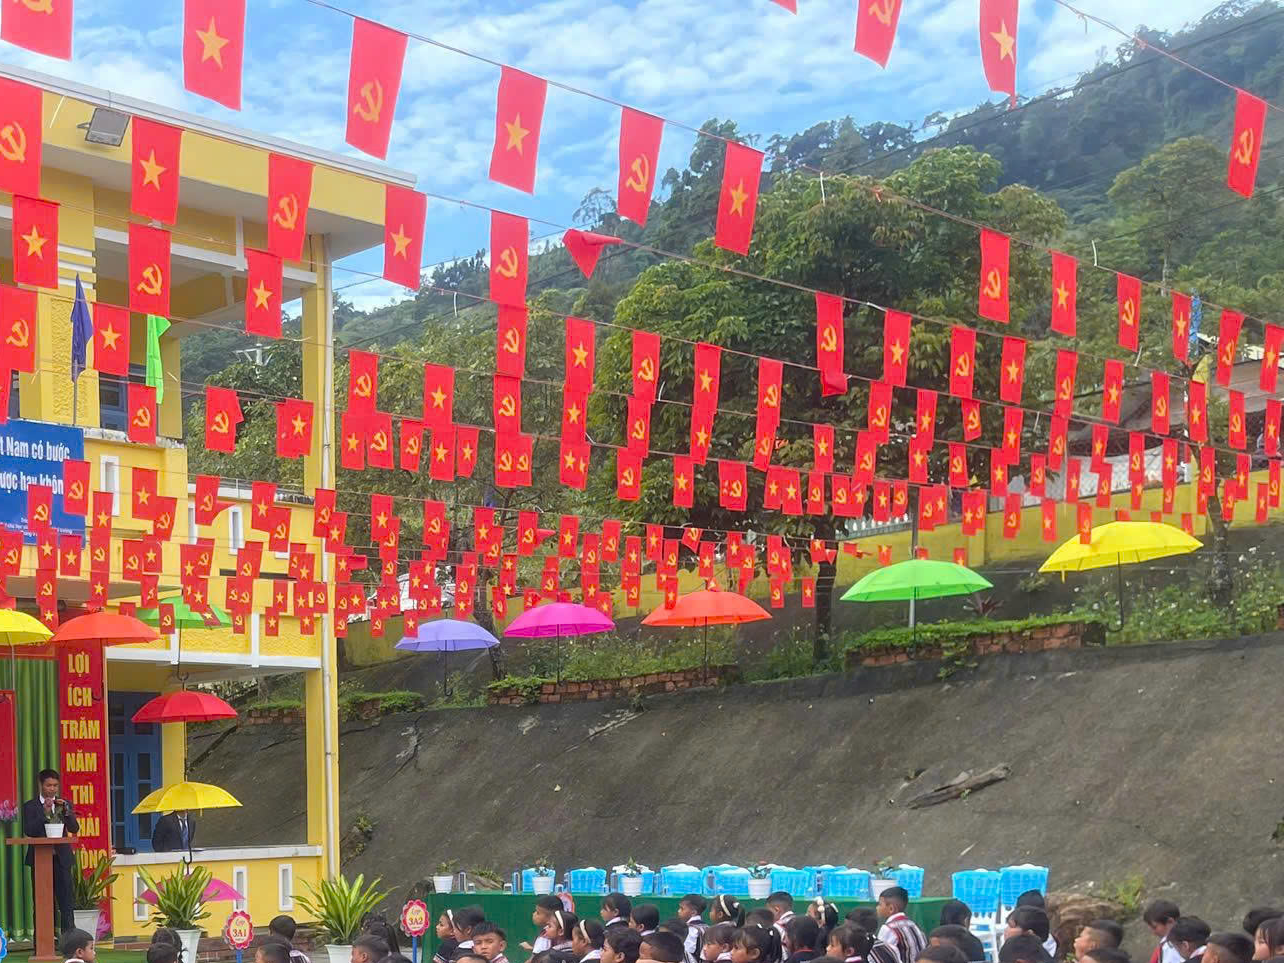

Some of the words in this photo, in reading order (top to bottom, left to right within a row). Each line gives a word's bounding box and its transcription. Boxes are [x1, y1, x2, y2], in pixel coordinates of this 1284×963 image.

[6, 436, 29, 458] Nam
[31, 440, 44, 460] có
[46, 441, 71, 462] bước
[39, 473, 64, 495] khôn
[68, 651, 90, 678] LỢI
[67, 684, 92, 707] ÍCH
[60, 716, 101, 740] TRĂM
[66, 749, 97, 771] NĂM
[71, 782, 94, 805] THÌ
